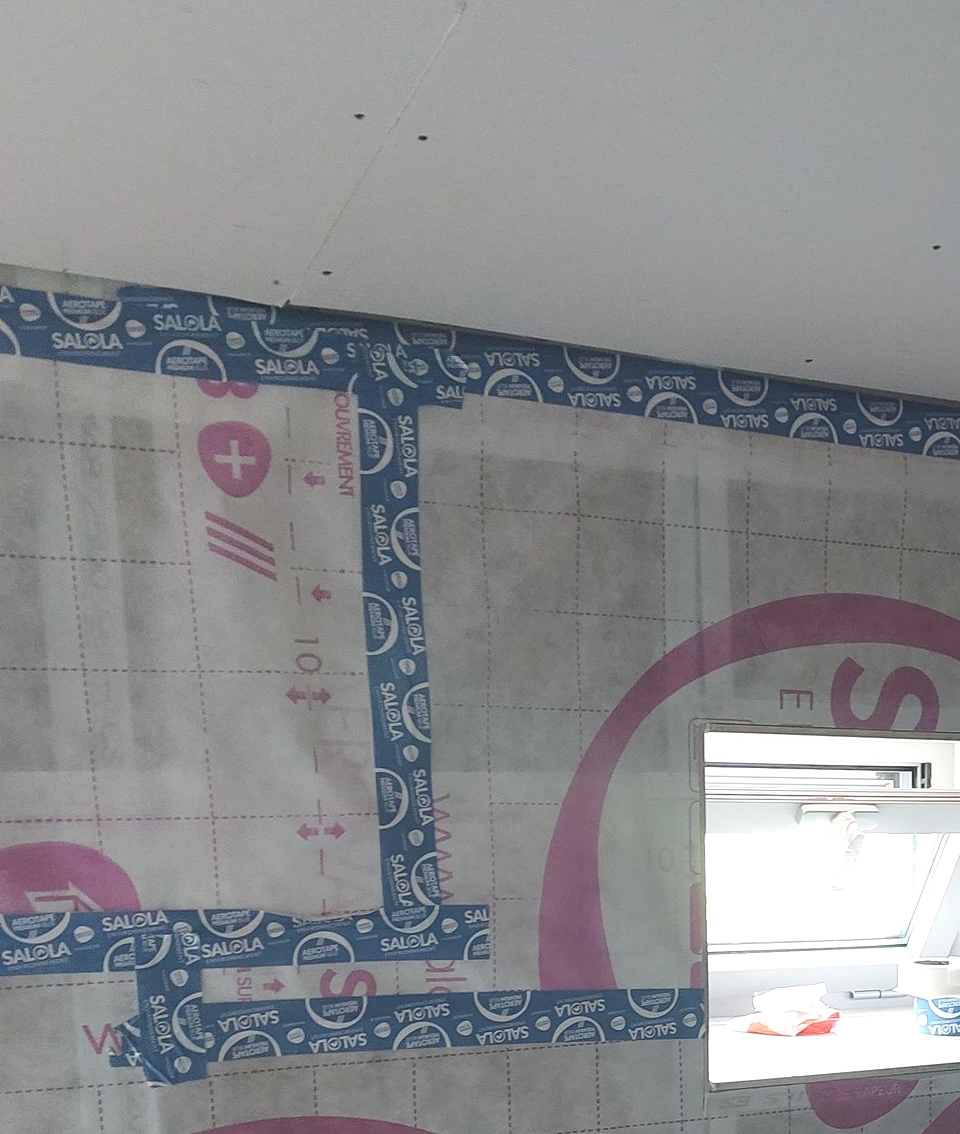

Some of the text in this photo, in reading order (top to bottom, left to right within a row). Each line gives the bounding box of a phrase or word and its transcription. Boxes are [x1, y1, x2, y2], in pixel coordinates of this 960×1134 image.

[153, 314, 222, 331] SALOLA
[51, 332, 124, 350] SALOLA
[253, 358, 320, 376] SALOLA
[484, 351, 542, 368] SALOLA
[644, 375, 697, 390] SALOLA
[568, 392, 621, 408] SALOLA
[790, 397, 838, 412] SALOLA
[720, 413, 770, 429] SALOLA
[398, 415, 418, 478] SALOLA
[858, 433, 904, 448] SALOLA
[371, 504, 393, 566] SALOLA
[402, 596, 426, 656] SALOLA
[293, 636, 322, 675] 10
[380, 682, 404, 742] SALOLA
[412, 768, 434, 826] SALOLA
[390, 853, 414, 908] SALOLA
[101, 910, 170, 932] SALOLA
[201, 937, 264, 958] SALOLA
[380, 932, 438, 952] SALOLA
[1, 942, 71, 966] SALOLA
[393, 1002, 450, 1024] SALOLA
[554, 999, 606, 1017] SALOLA
[150, 994, 176, 1055] SALOLA
[217, 1009, 280, 1033] SALOLA
[628, 1022, 677, 1040] SALOLA
[308, 1032, 368, 1054] SALOLA
[475, 1025, 529, 1046] SALOLA
